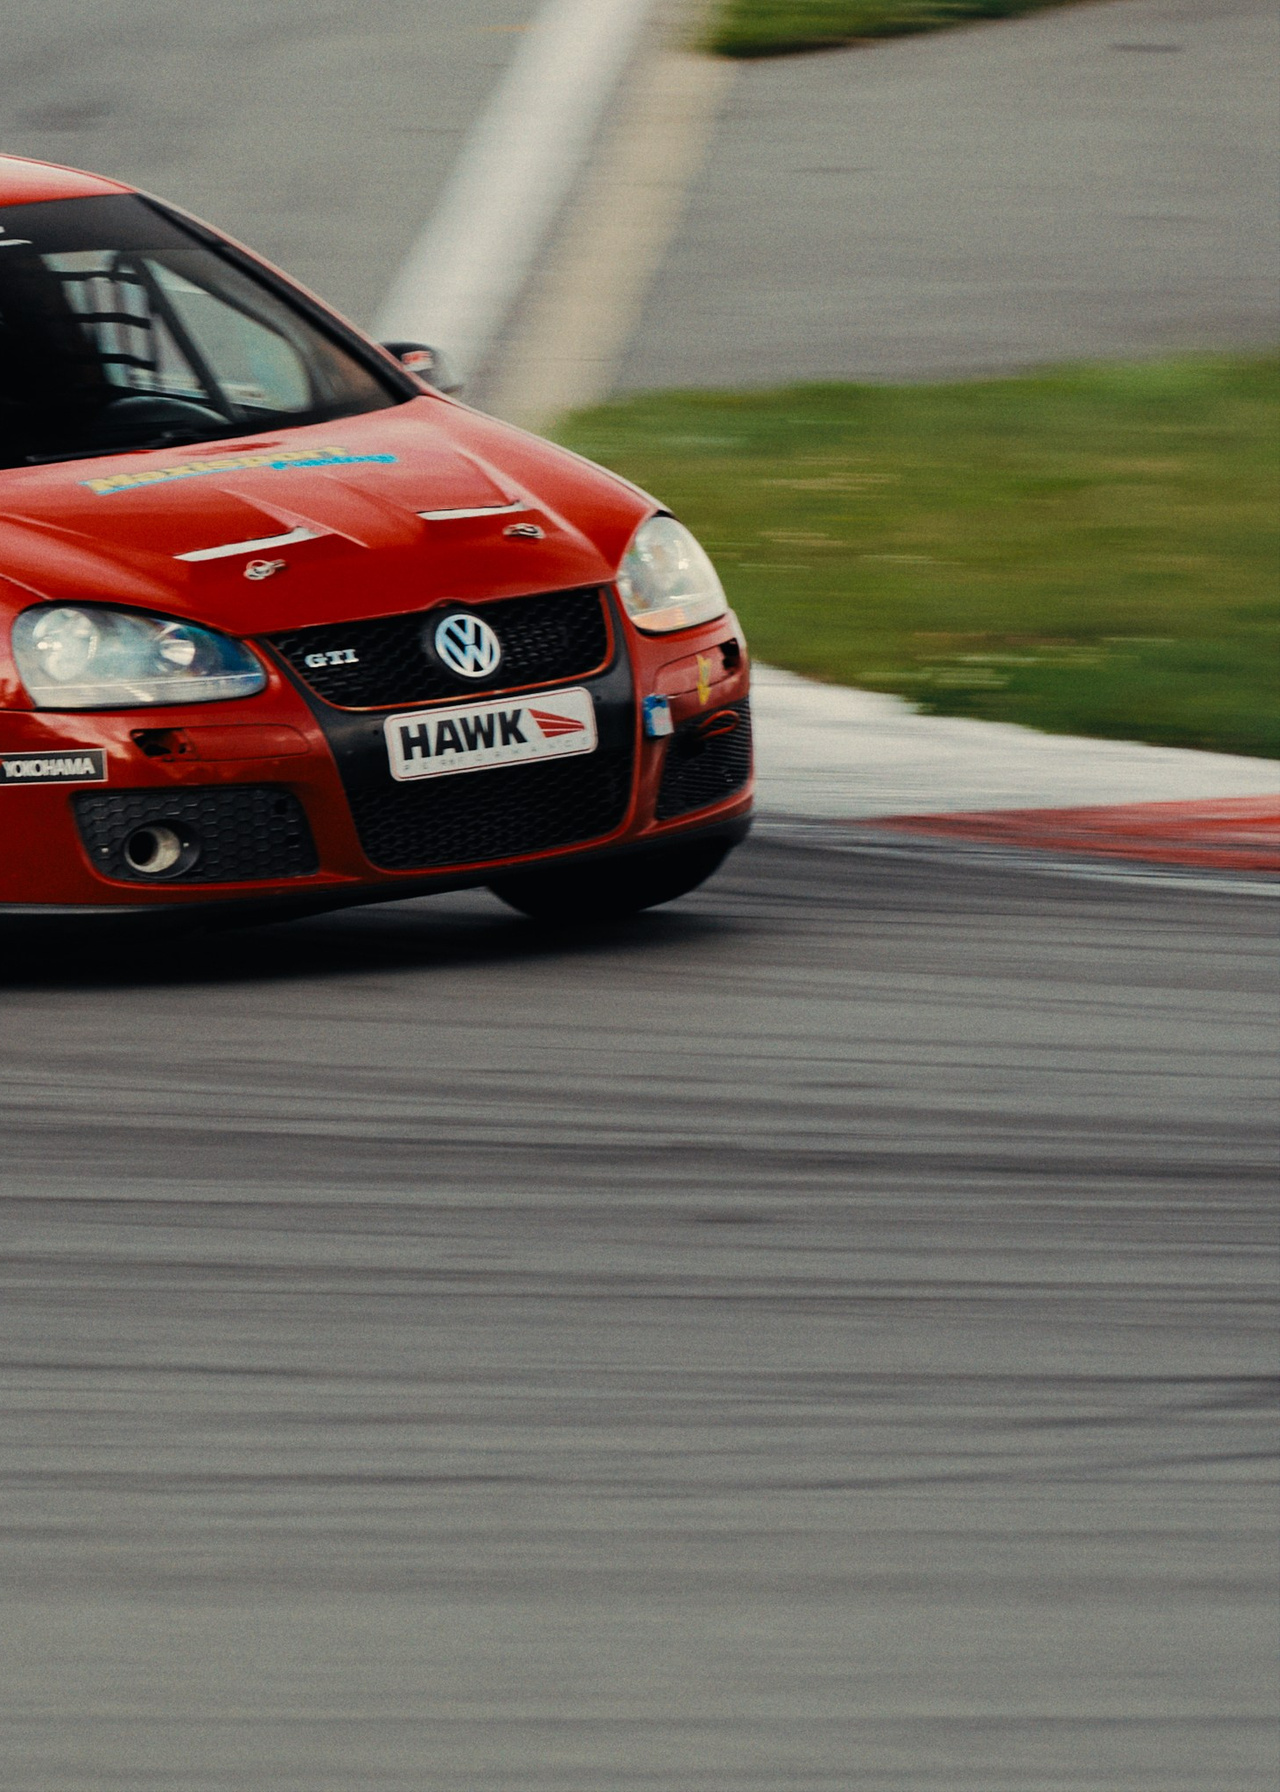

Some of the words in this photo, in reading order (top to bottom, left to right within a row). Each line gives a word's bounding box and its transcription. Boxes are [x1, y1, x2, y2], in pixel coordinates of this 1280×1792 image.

[304, 648, 360, 668] GTI
[399, 708, 528, 761] HAWK
[1, 757, 96, 778] YOKOHAMA
